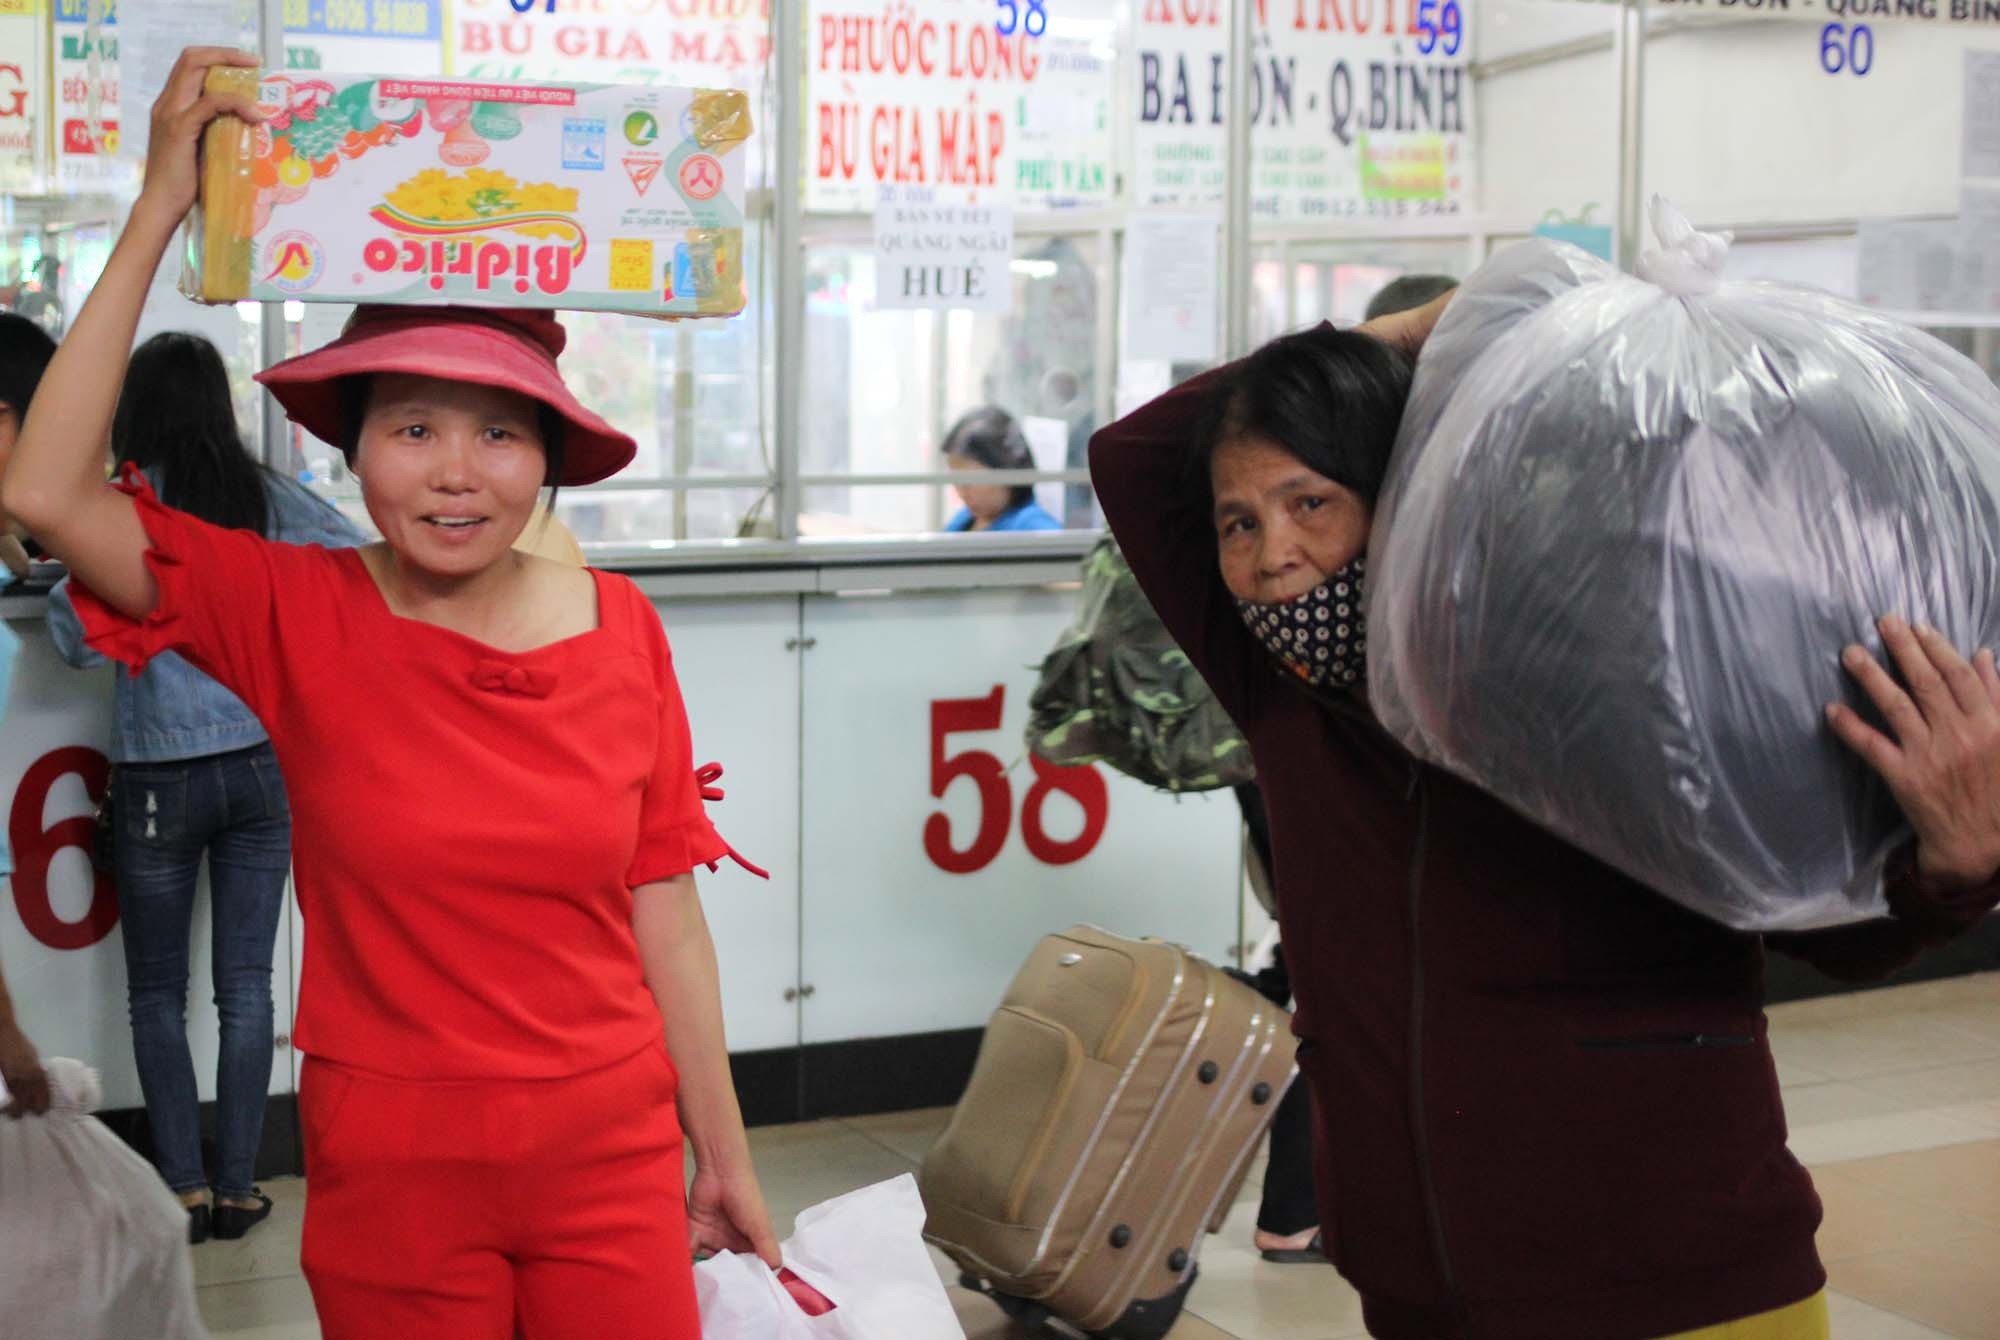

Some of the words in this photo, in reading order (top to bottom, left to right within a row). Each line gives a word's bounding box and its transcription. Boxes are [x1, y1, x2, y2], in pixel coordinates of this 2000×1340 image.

[555, 26, 648, 61] GIA
[819, 2, 937, 77] PHƯỚC
[947, 22, 1040, 83] LONG
[996, 0, 1047, 36] 58
[1417, 0, 1462, 55] 59
[1819, 22, 1873, 75] 60
[1140, 51, 1195, 126] BA
[869, 102, 927, 184] GIA
[363, 237, 573, 295] Bidrico
[901, 255, 988, 298] HUẾ
[922, 683, 1110, 875] 58
